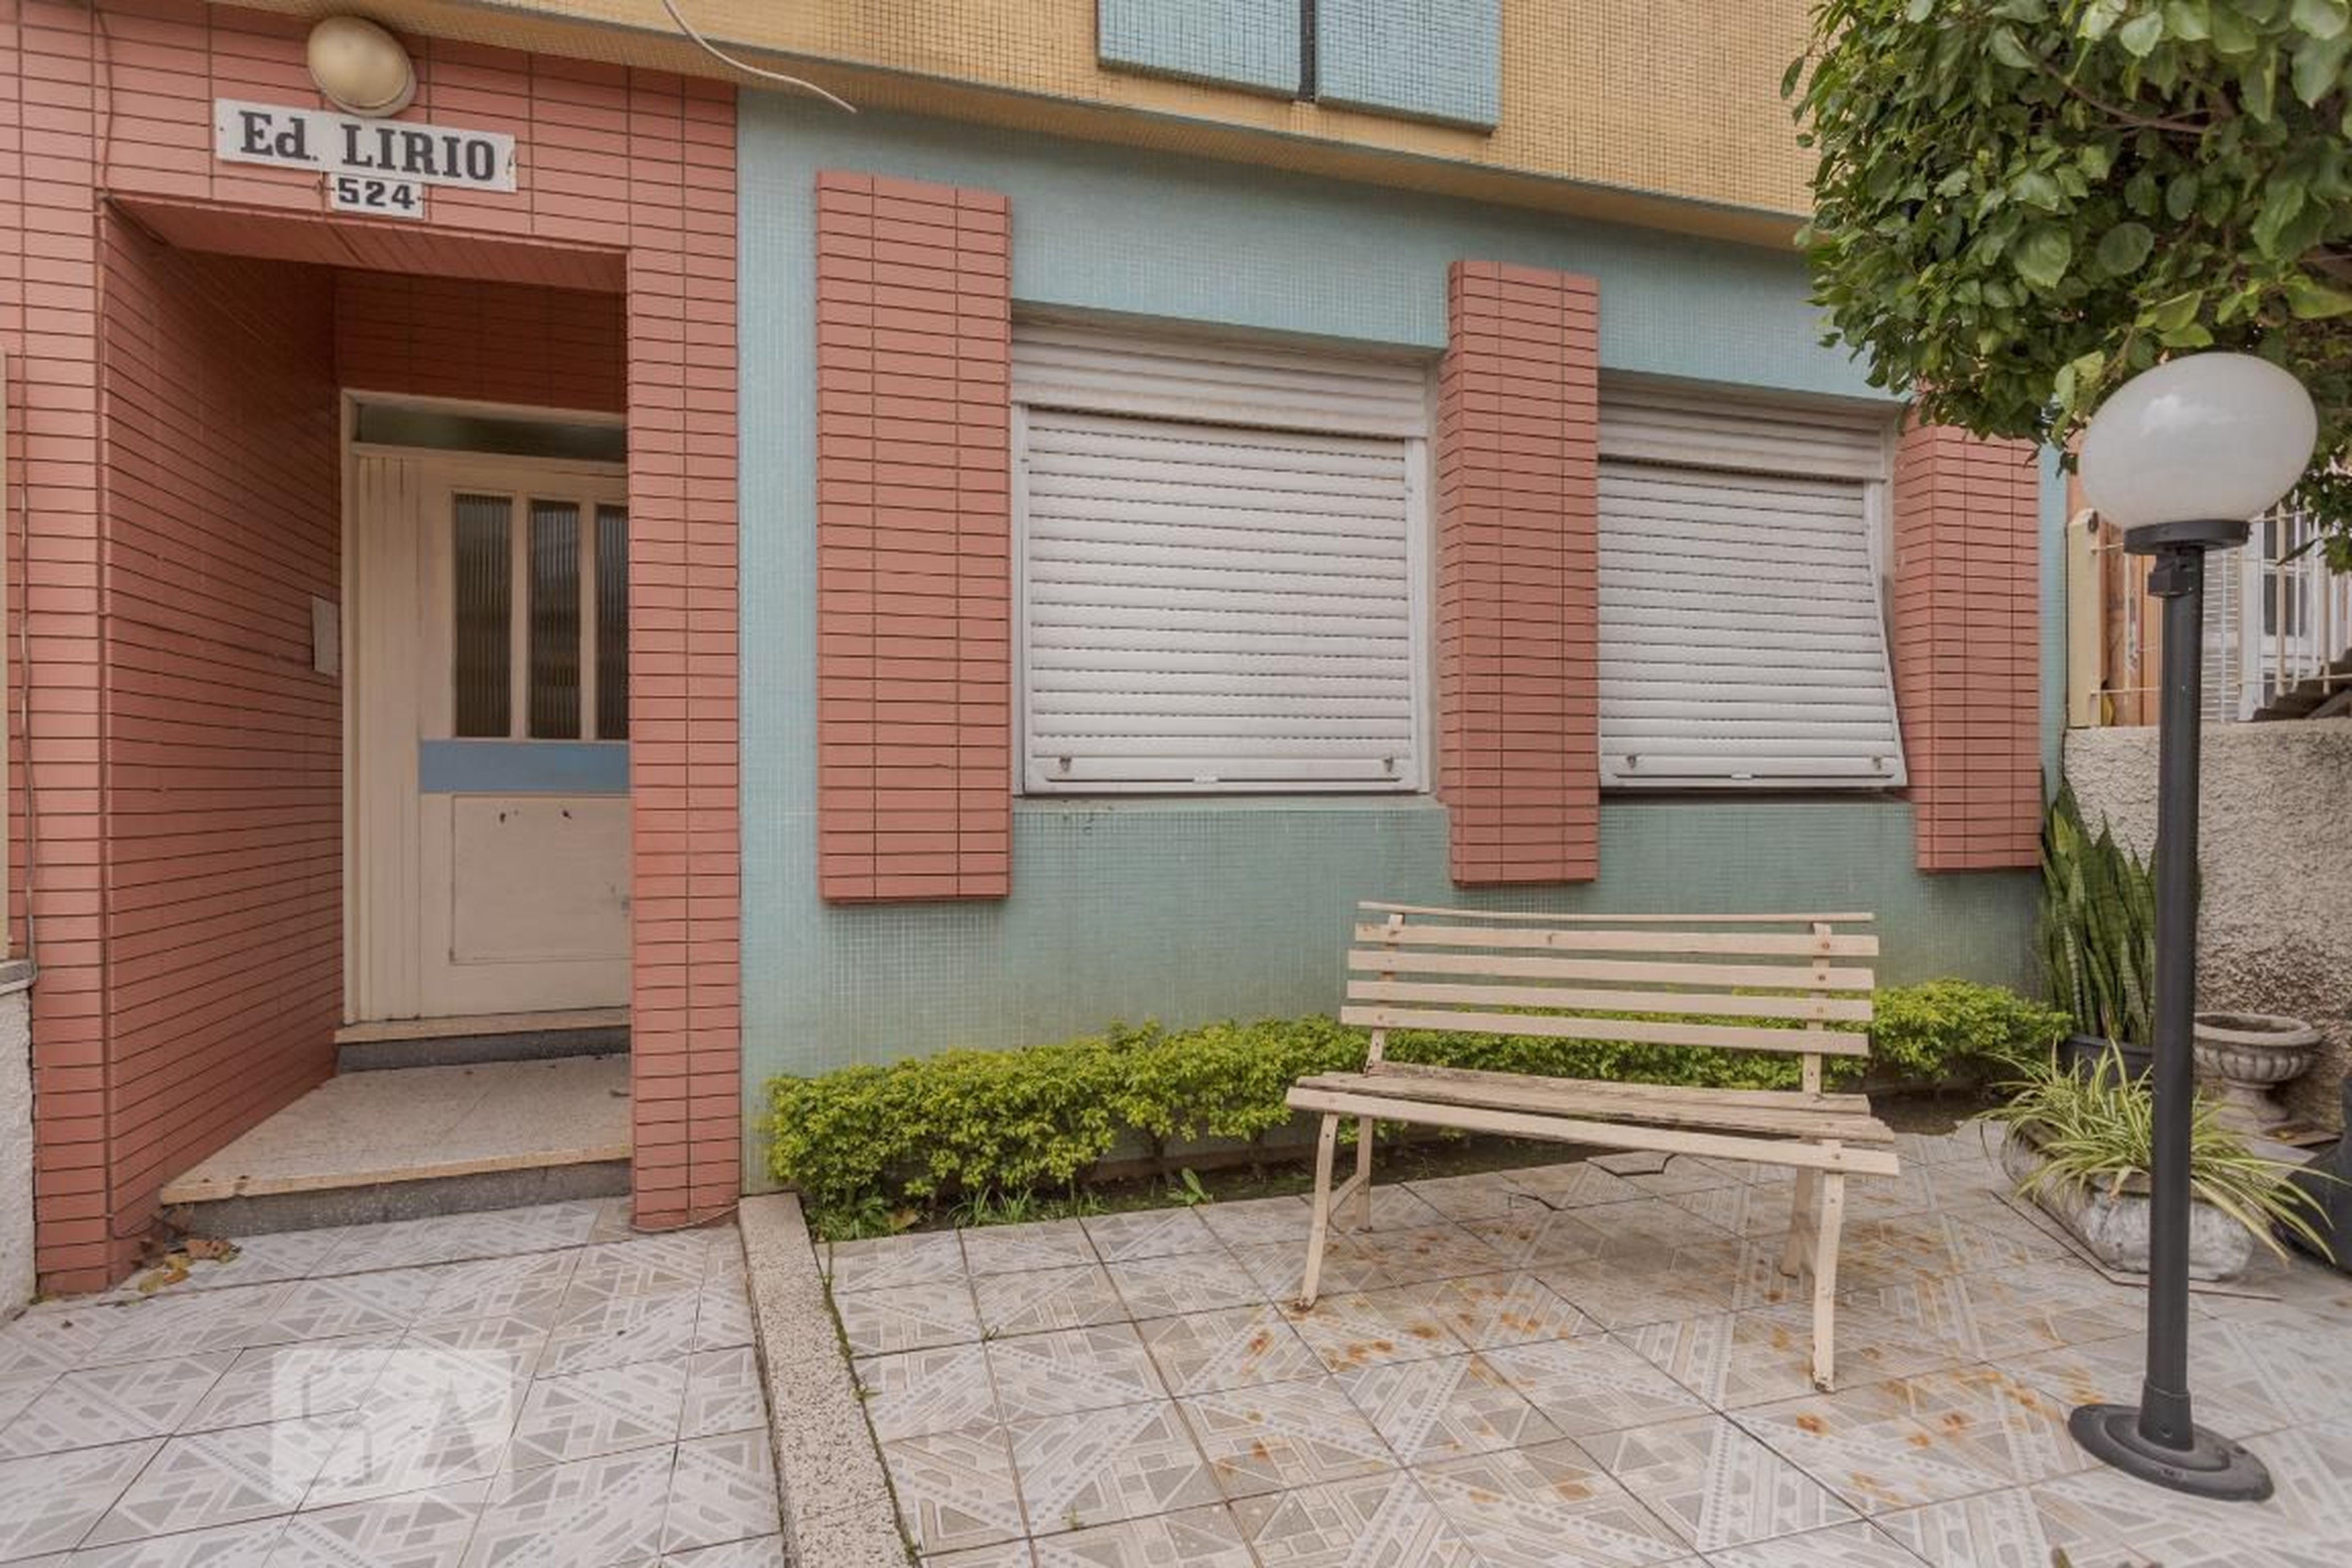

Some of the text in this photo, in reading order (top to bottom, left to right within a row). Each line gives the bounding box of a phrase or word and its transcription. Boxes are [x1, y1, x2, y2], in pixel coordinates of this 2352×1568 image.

[239, 111, 495, 181] Ed. LIRIO
[338, 178, 415, 209] 524
